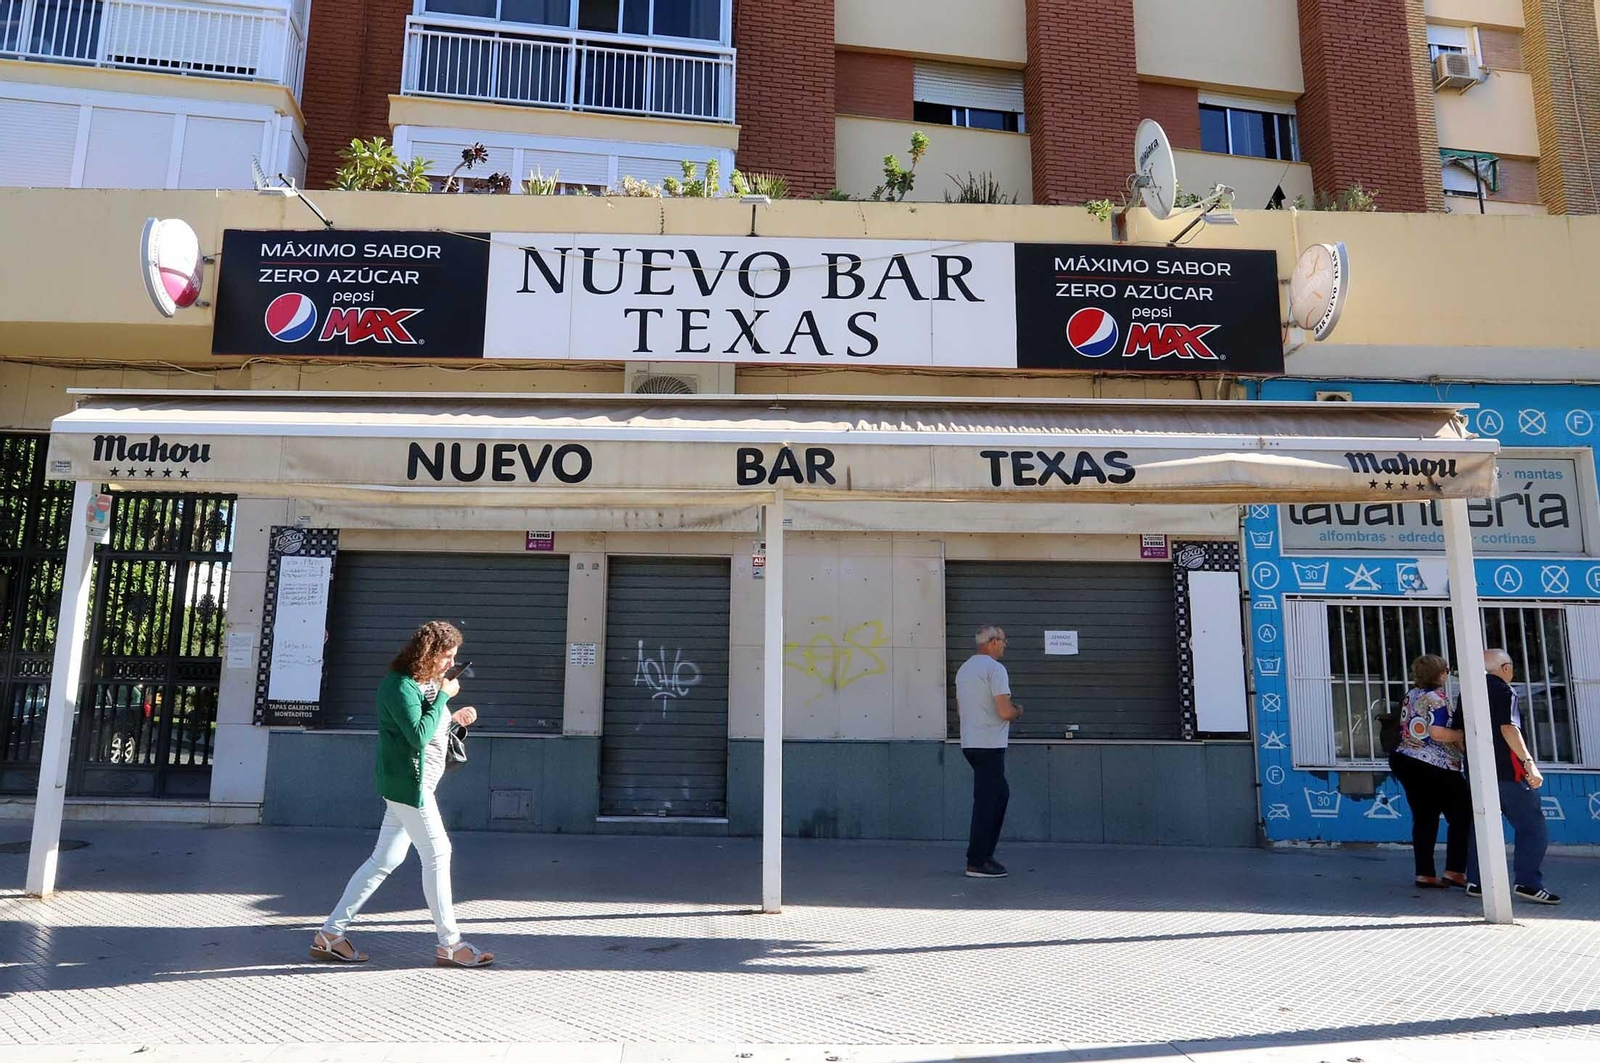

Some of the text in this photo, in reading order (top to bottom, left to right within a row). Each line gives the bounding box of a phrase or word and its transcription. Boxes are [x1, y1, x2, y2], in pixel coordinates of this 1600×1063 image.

[261, 240, 442, 259] MÁXIMO SABOR
[258, 267, 420, 285] ZERO AZÚCAR
[516, 246, 986, 302] NUEVO BAR
[1054, 255, 1232, 276] MÁXIMO SABOR
[332, 290, 375, 305] pepsi
[1055, 282, 1214, 301] ZERO AZÚCAR
[1131, 306, 1172, 320] pepsi
[318, 307, 425, 345] MAX
[624, 307, 879, 357] TEXAS
[1122, 322, 1222, 360] MAX
[93, 434, 212, 463] Mahou
[406, 442, 1137, 487] NUEVO BAR TEXAS
[1344, 452, 1458, 479] Mahou
[1514, 468, 1564, 480] mantas
[1319, 530, 1387, 543] alfombras
[1481, 532, 1537, 545] cortinas
